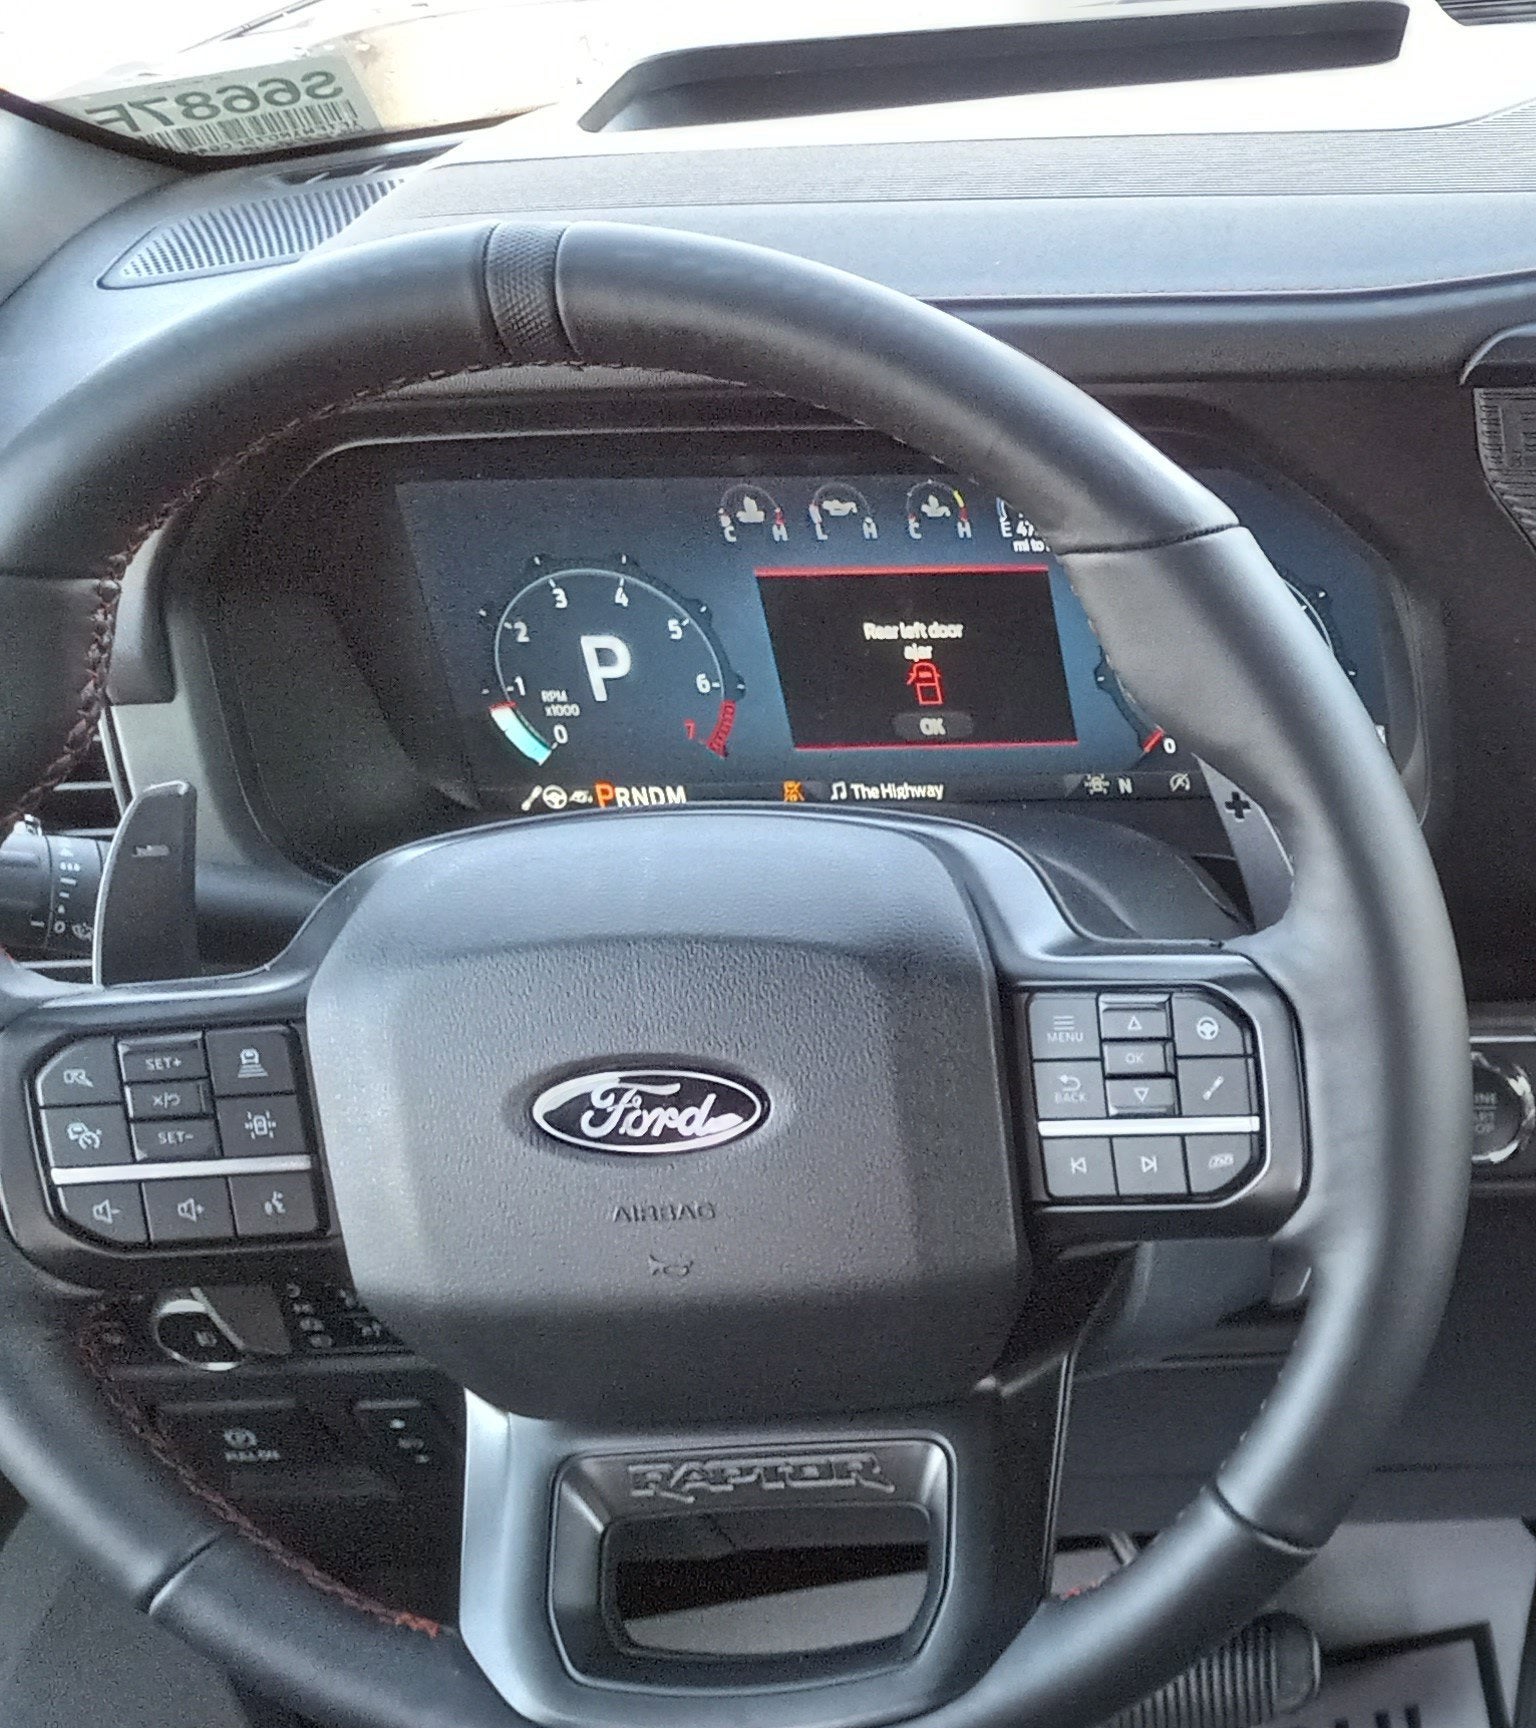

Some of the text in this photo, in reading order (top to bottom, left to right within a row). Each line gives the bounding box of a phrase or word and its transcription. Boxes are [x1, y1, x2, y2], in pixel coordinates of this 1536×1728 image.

[553, 588, 568, 609] 3
[614, 587, 629, 608] 4
[514, 621, 530, 643] 2
[668, 619, 683, 640] 5
[863, 621, 963, 640] Rear left door
[580, 634, 632, 702] P
[696, 674, 711, 694] 6
[553, 724, 569, 745] 0
[920, 717, 946, 735] OK
[850, 782, 945, 803] The Highway
[1118, 777, 1132, 795] N
[1046, 1032, 1084, 1043] MENU
[1125, 1052, 1144, 1064] OK
[1054, 1092, 1088, 1103] BACK
[580, 1082, 744, 1139] Ford
[627, 1451, 896, 1504] RAPTOR
